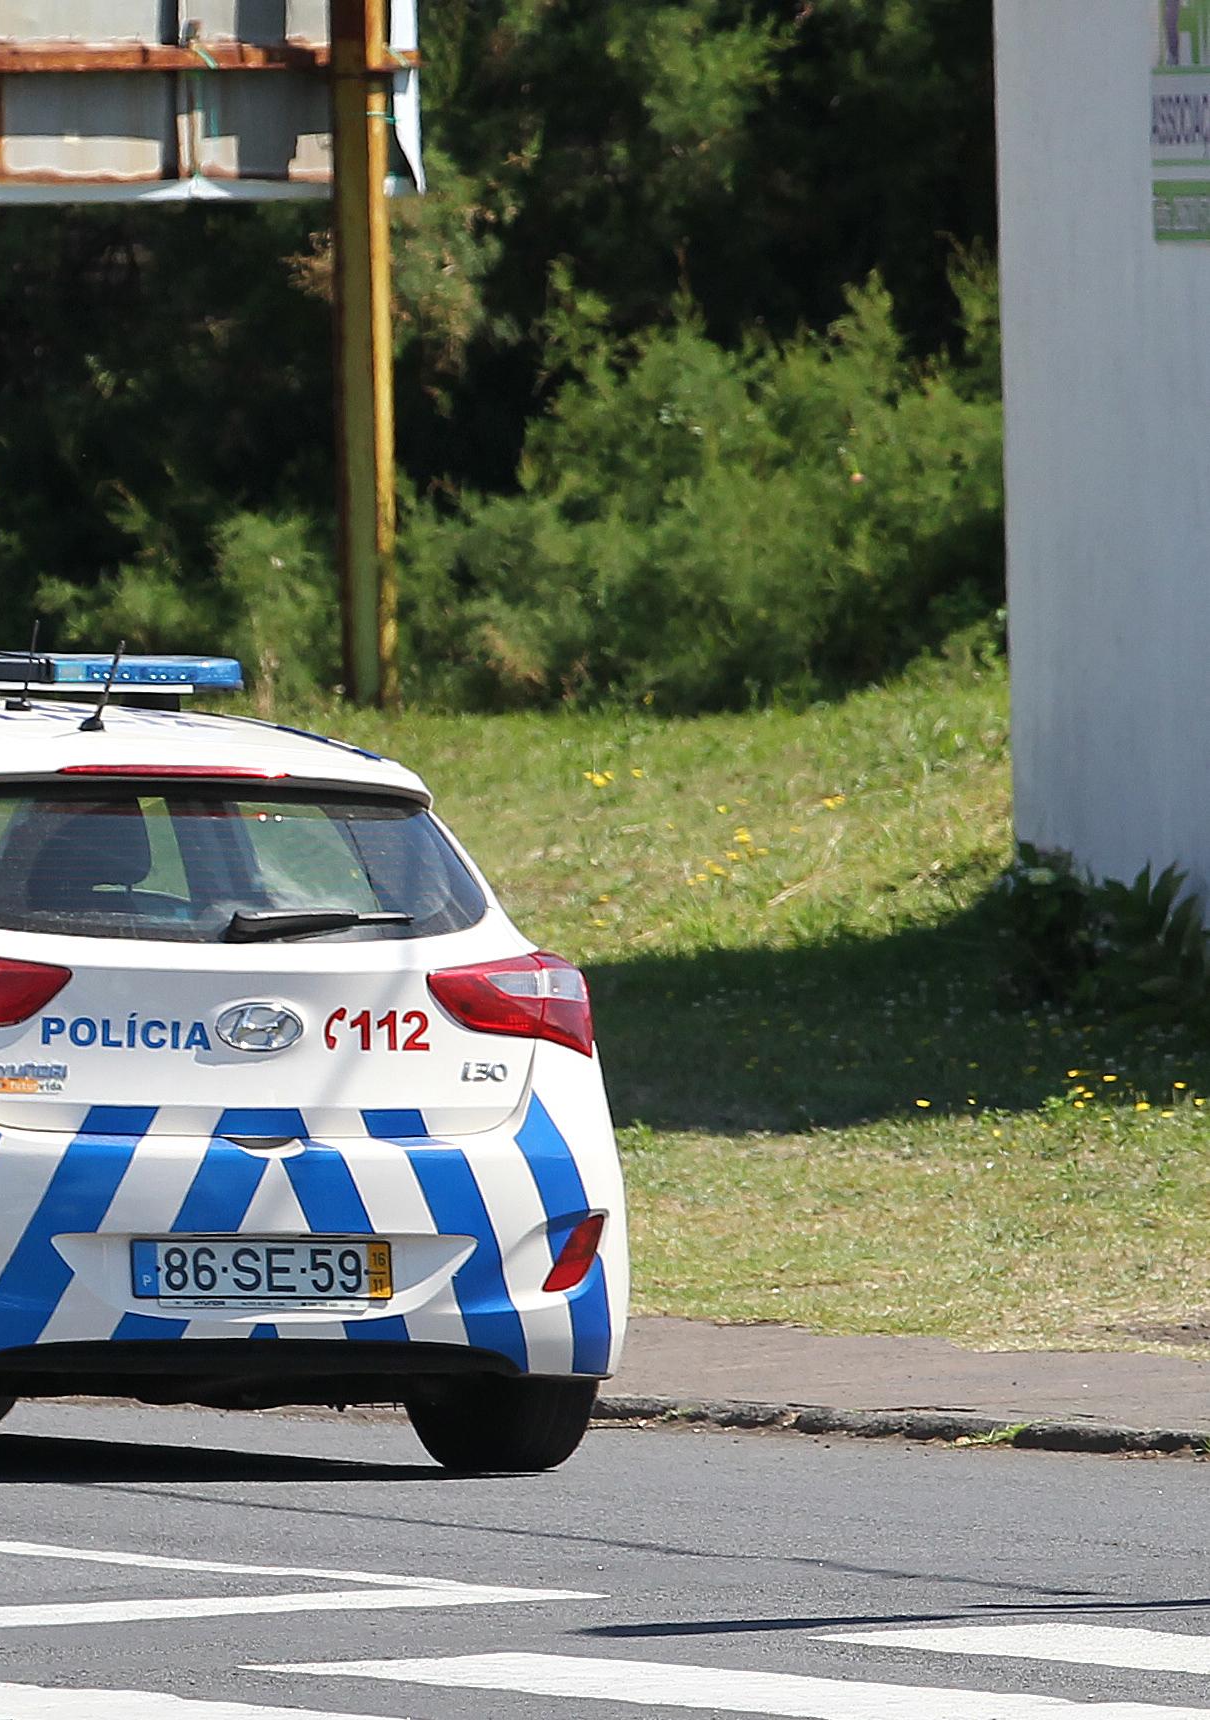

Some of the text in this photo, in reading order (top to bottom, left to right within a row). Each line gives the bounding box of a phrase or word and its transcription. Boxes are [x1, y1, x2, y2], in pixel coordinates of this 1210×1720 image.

[40, 1012, 211, 1052] POLÍCIA
[349, 1010, 430, 1051] 112
[372, 1252, 387, 1266] 16
